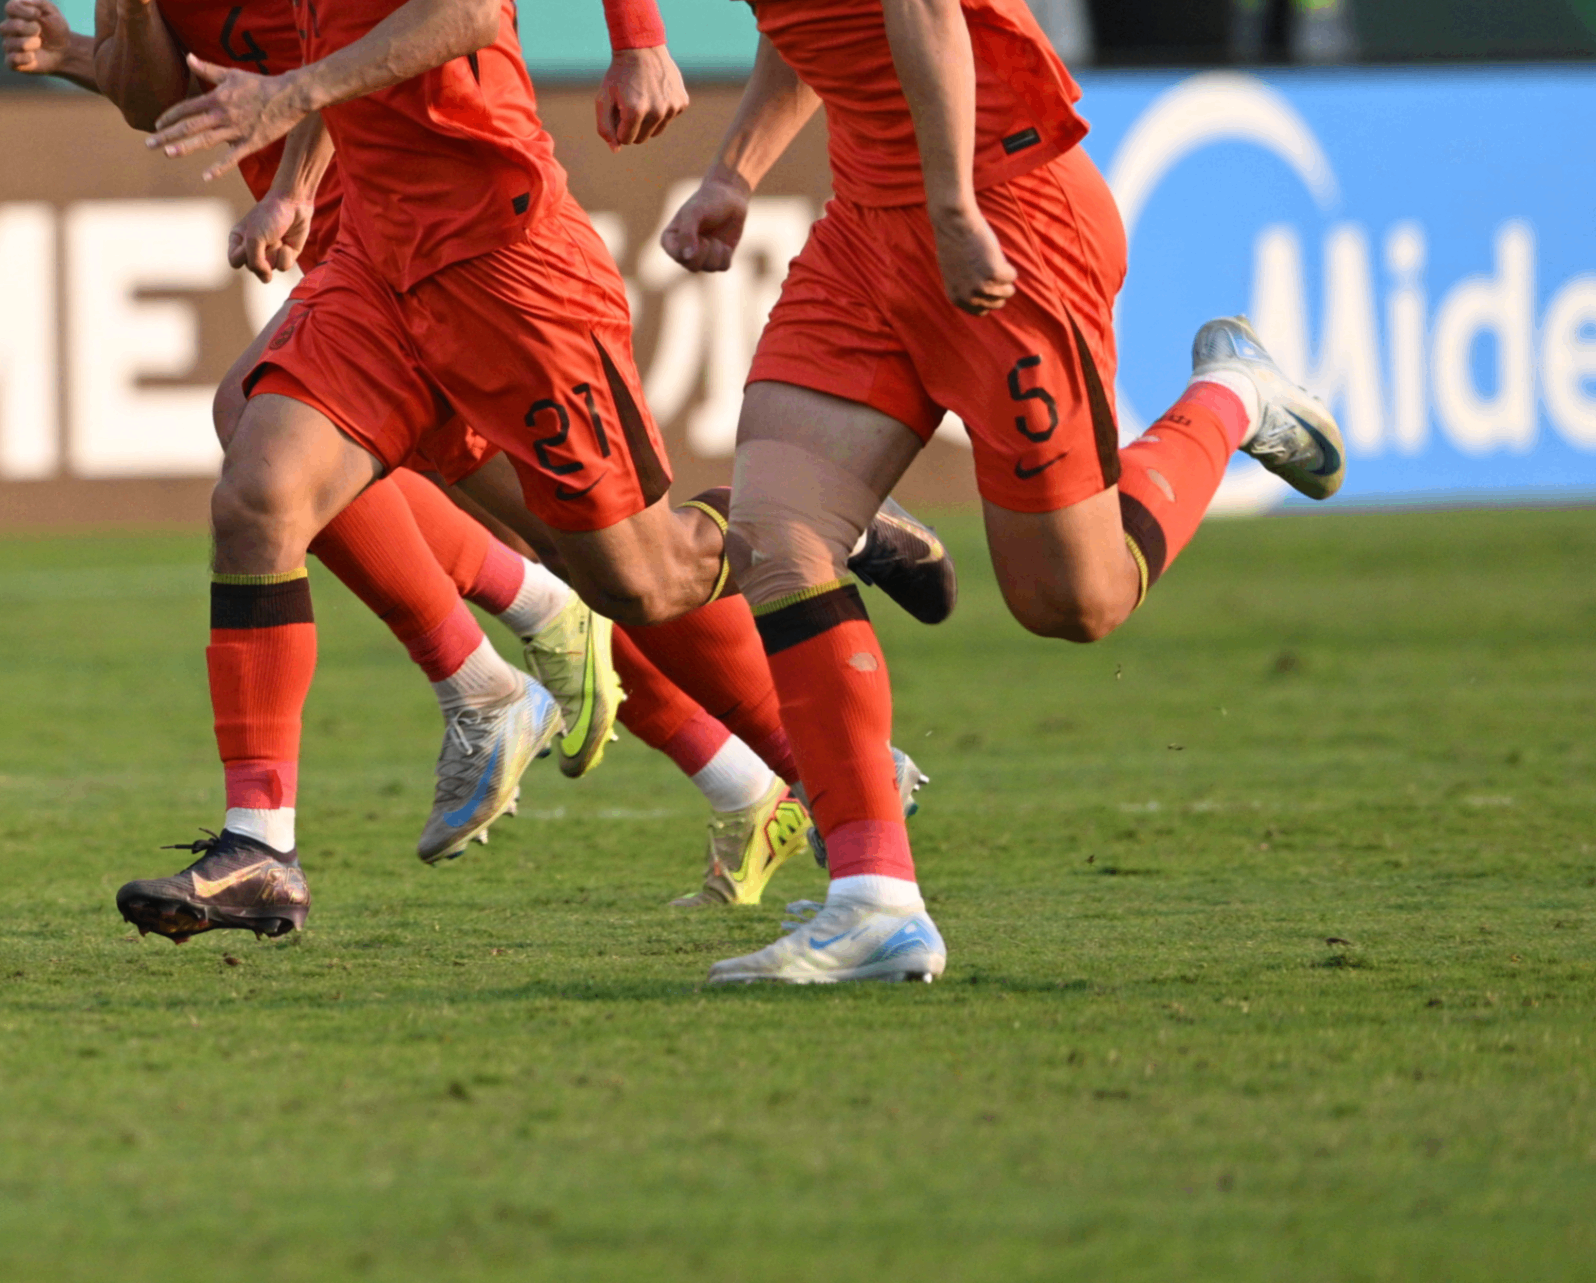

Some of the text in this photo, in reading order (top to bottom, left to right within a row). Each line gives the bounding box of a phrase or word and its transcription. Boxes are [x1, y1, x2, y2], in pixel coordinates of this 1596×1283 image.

[219, 5, 268, 76] 4
[524, 382, 611, 476] 21
[1008, 354, 1058, 443] 5
